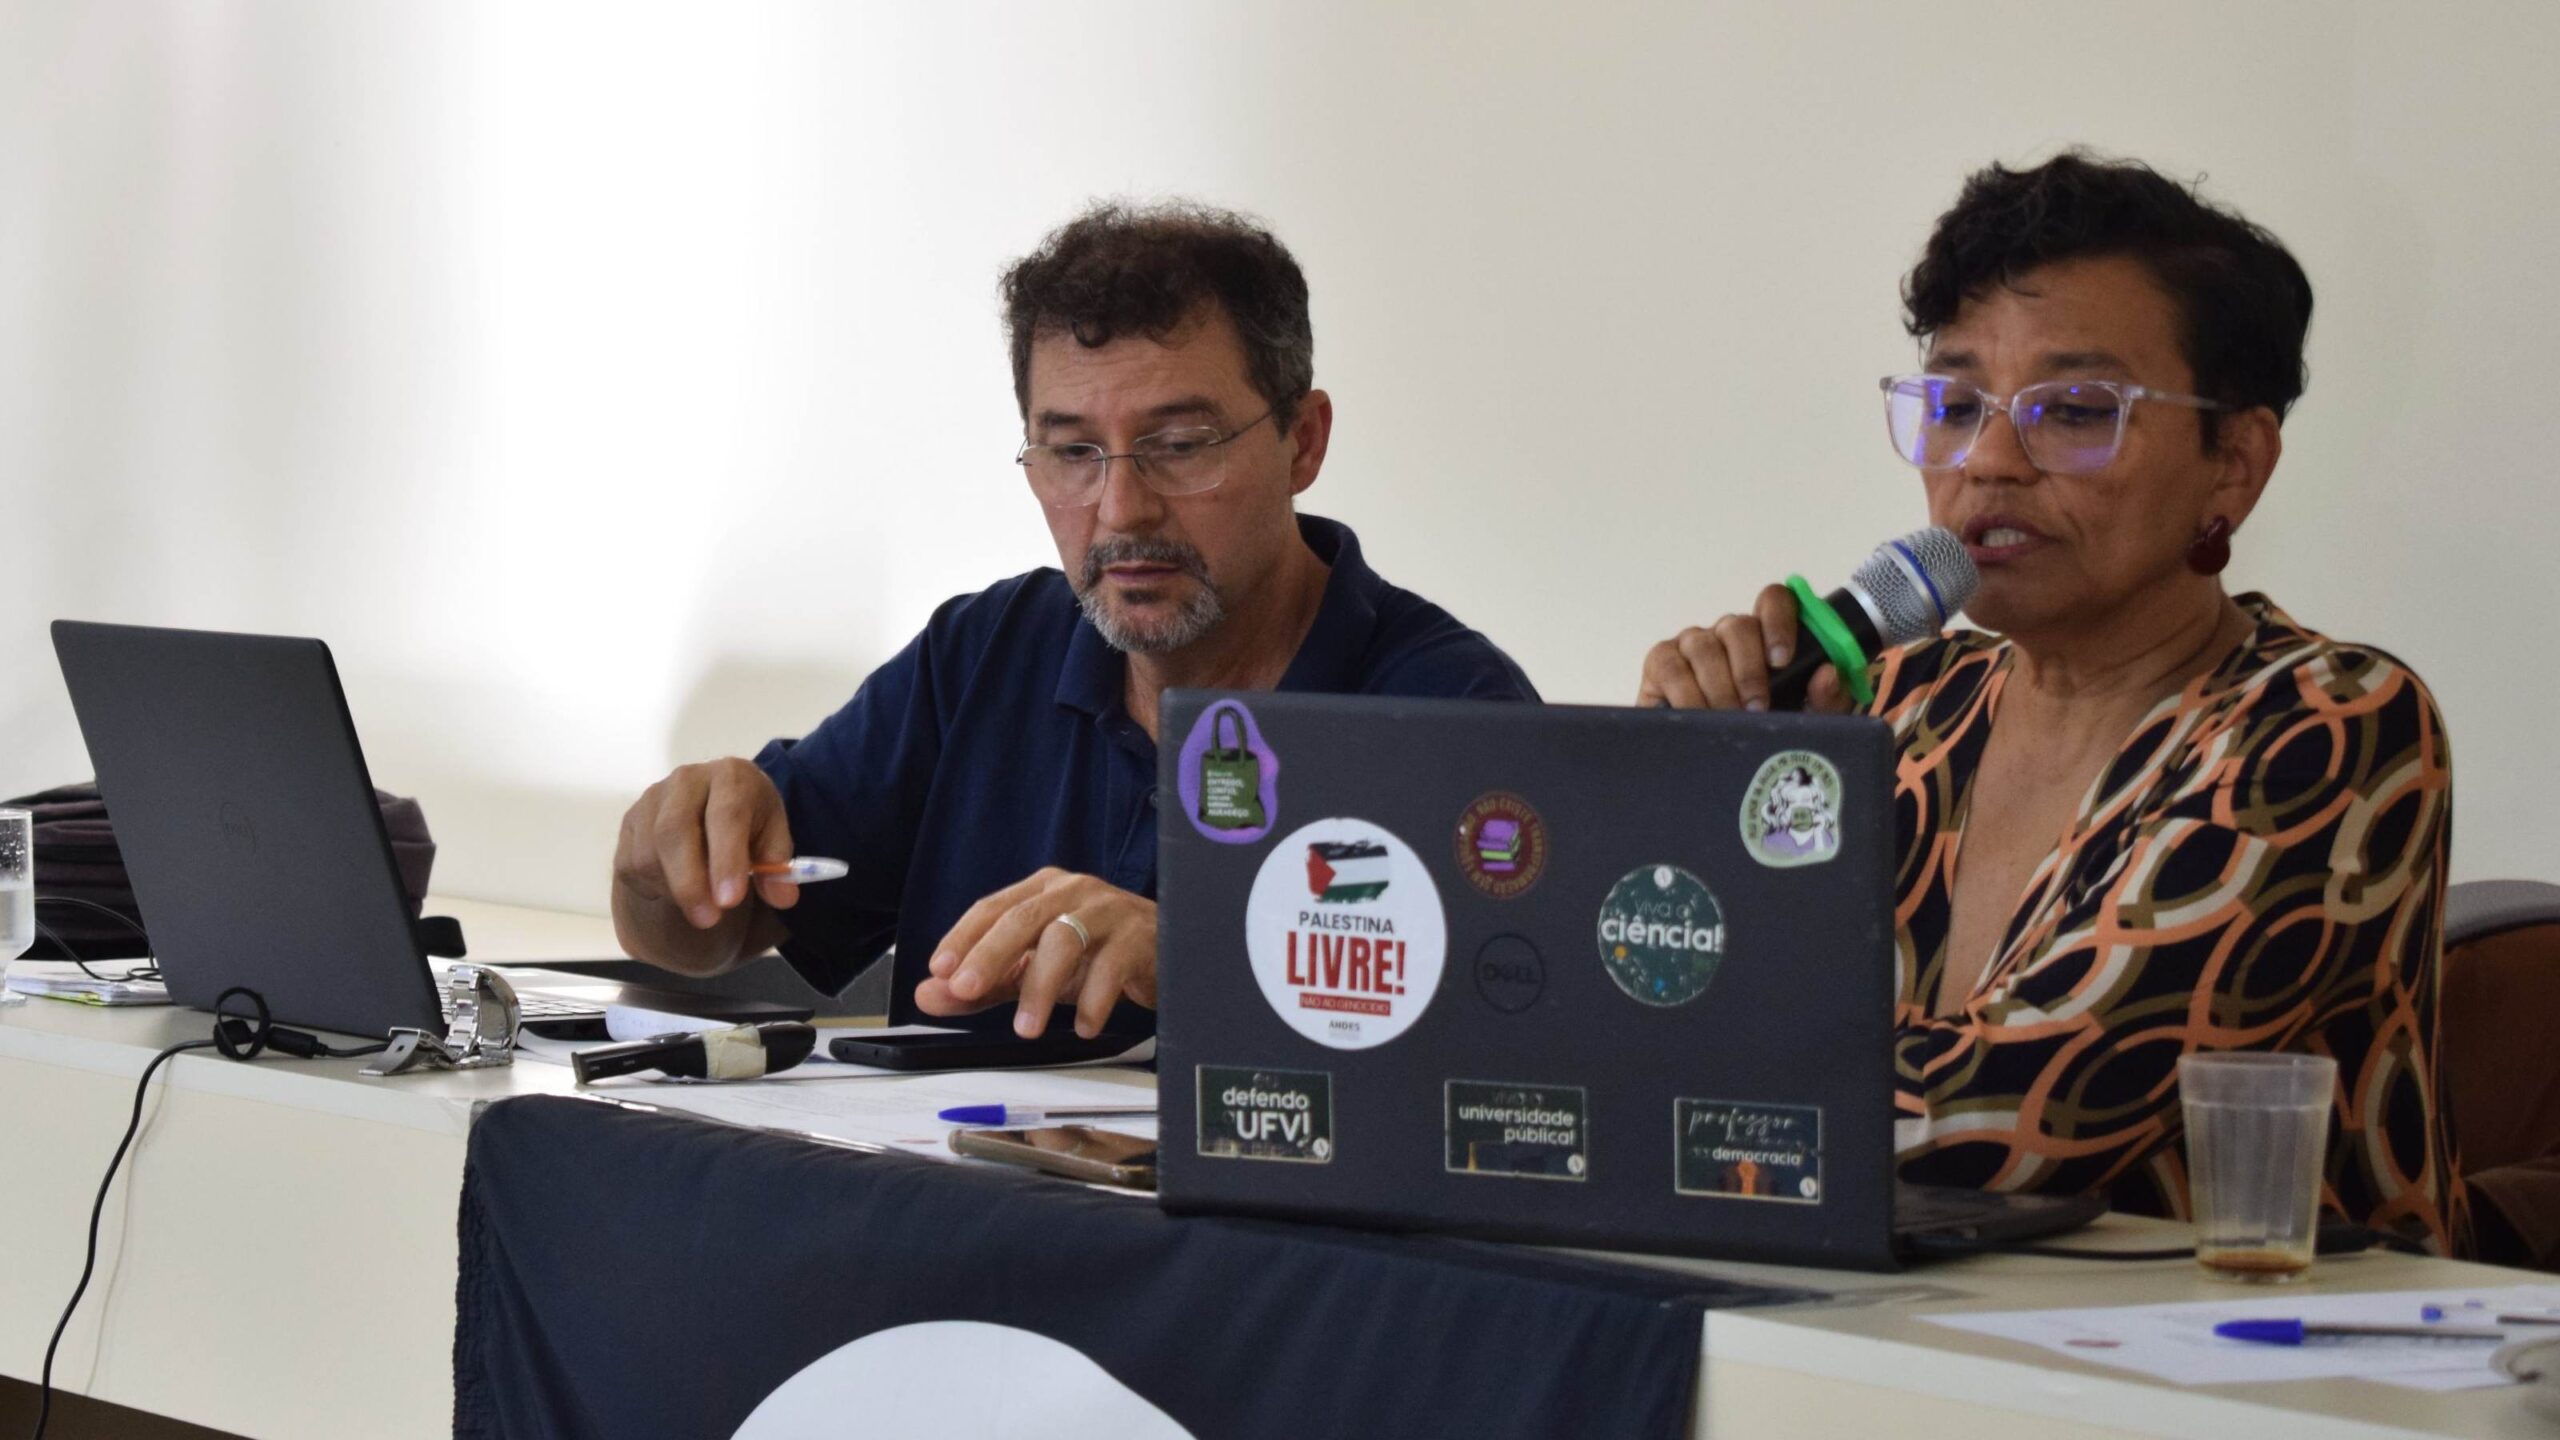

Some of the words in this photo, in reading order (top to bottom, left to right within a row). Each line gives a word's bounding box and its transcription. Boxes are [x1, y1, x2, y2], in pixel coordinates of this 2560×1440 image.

[1635, 900, 1672, 918] viva
[1299, 911, 1395, 934] PALESTINA
[1600, 914, 1724, 953] ciência!
[1287, 931, 1406, 995] LIVRE!
[1222, 1086, 1310, 1110] defendo
[1459, 1104, 1575, 1127] universidade
